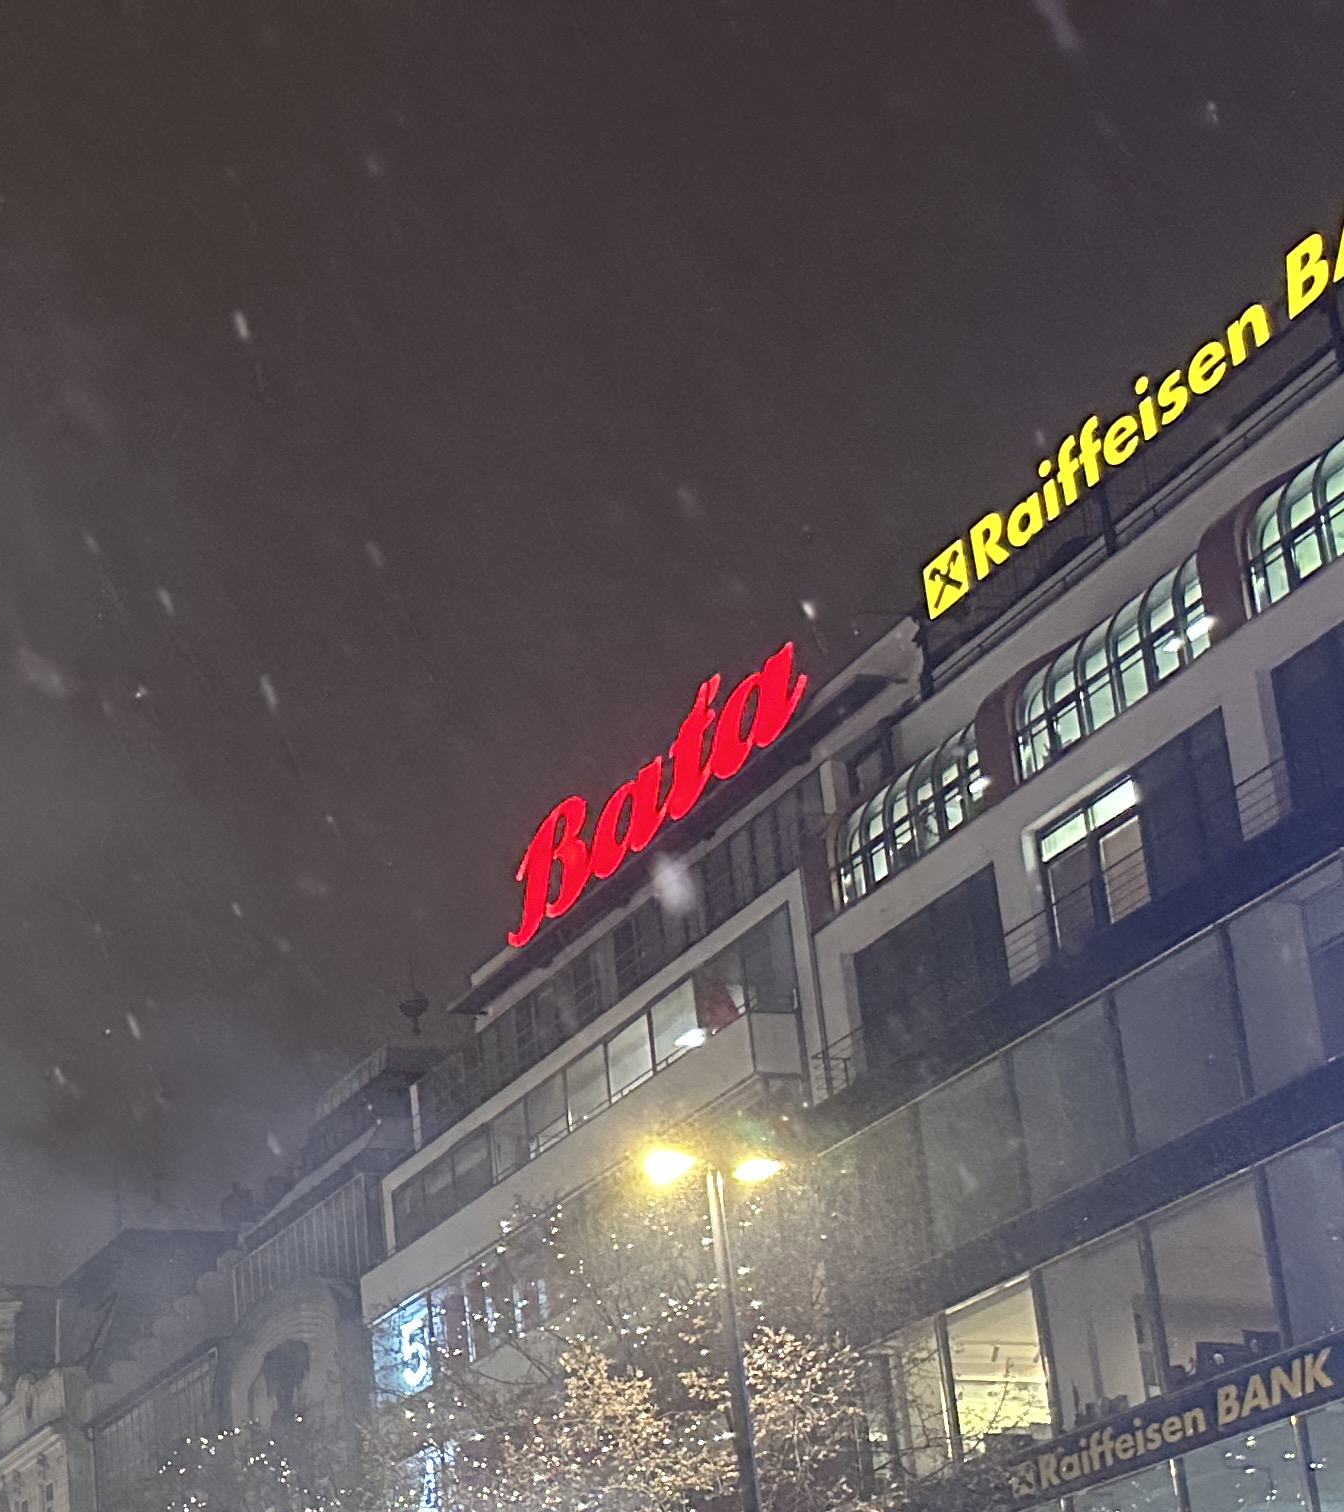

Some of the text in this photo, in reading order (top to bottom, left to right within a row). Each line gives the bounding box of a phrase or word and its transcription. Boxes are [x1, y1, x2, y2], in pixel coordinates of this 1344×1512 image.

[968, 301, 1271, 585] Raiffeisen
[1037, 1345, 1335, 1491] Raiffeisen BANK
